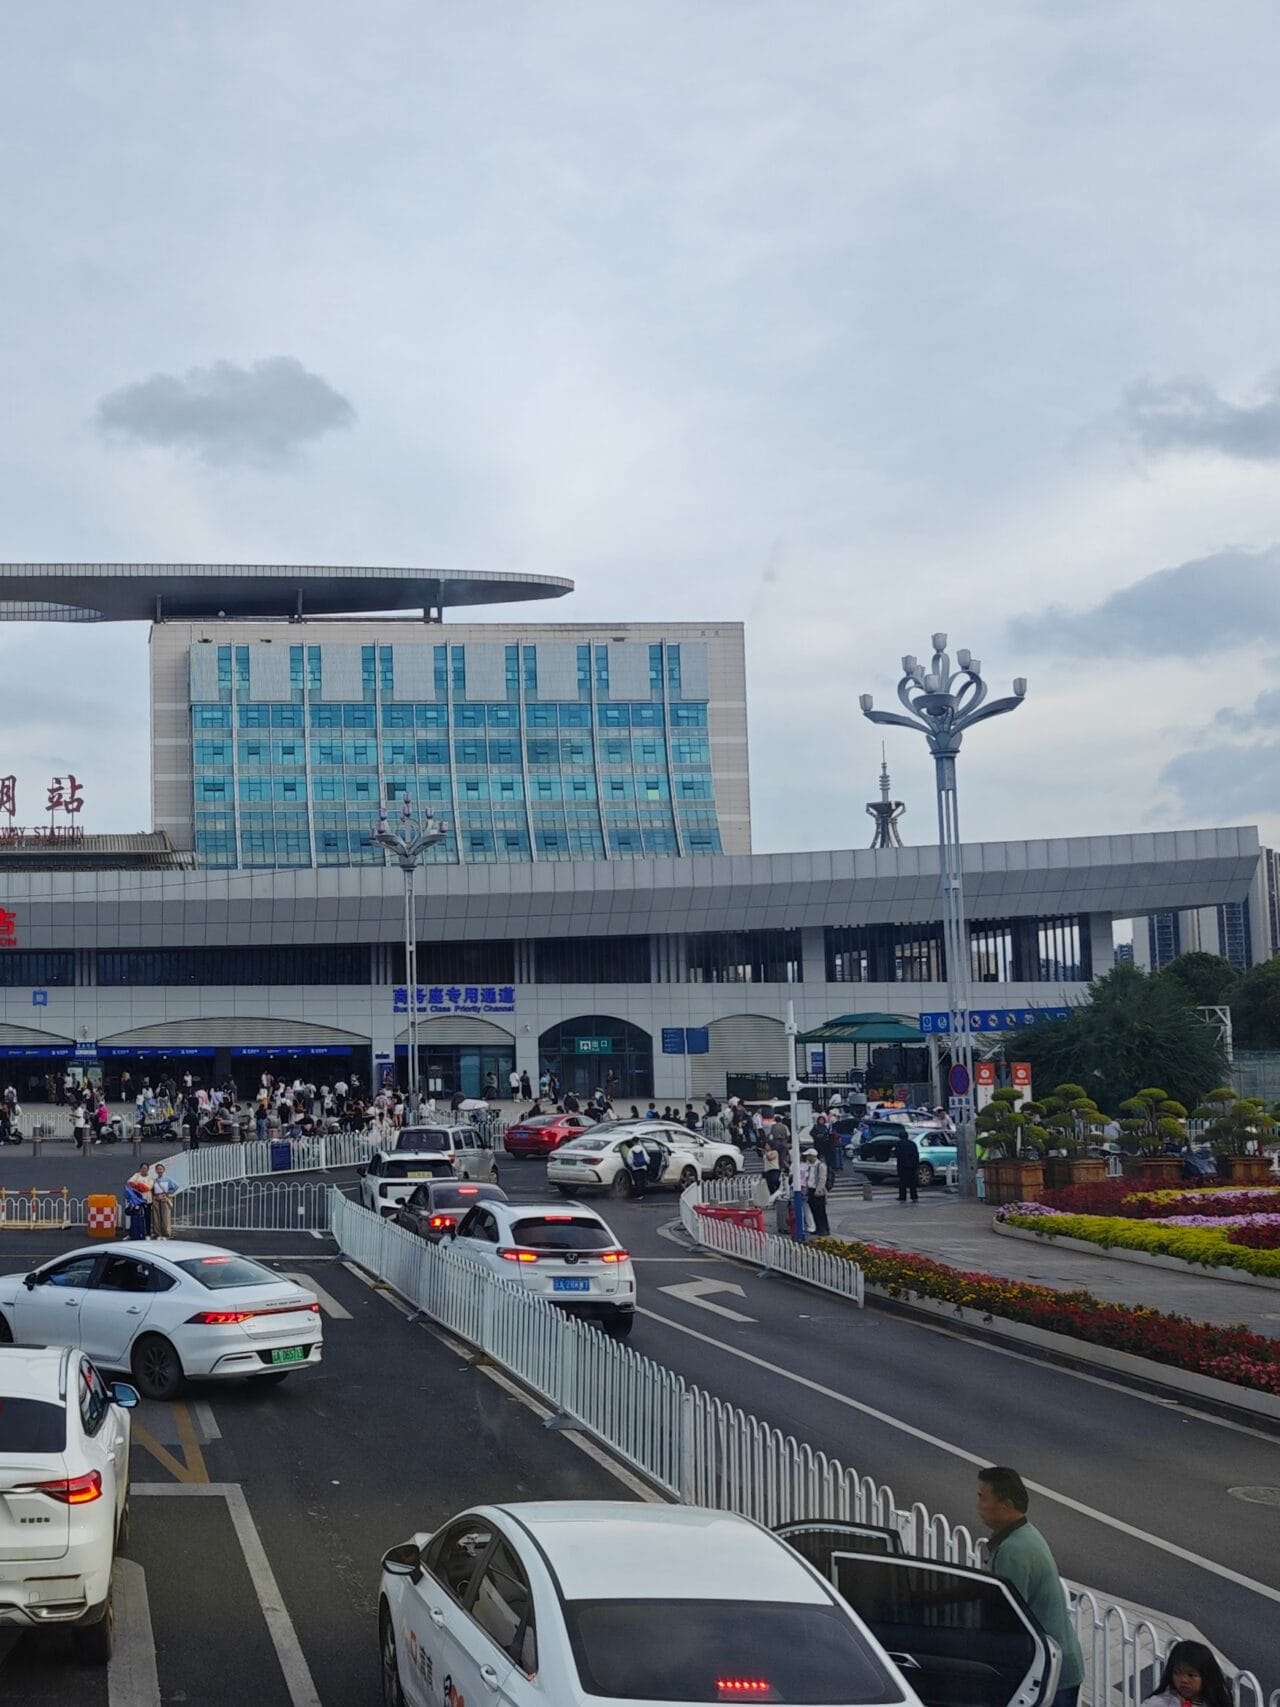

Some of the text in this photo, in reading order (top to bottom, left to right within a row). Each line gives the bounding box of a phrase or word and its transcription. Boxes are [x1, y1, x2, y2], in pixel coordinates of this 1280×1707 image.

[34, 826, 85, 840] STATION
[393, 986, 515, 1005] 商务座专用通道
